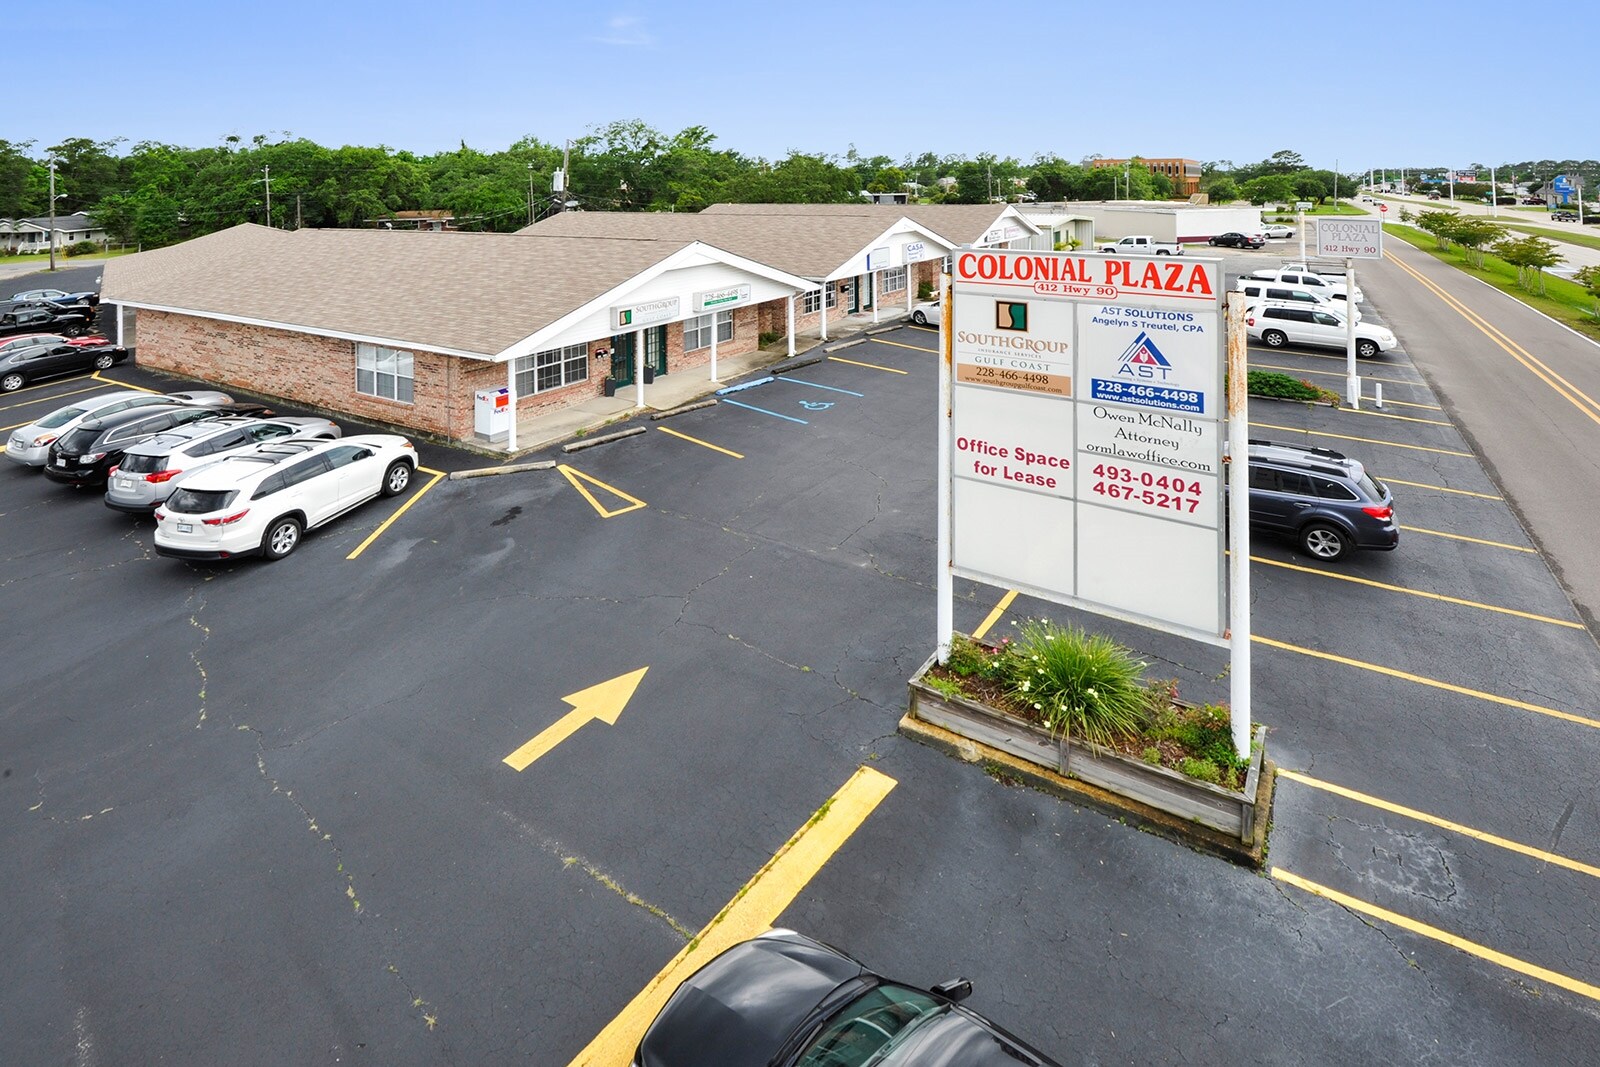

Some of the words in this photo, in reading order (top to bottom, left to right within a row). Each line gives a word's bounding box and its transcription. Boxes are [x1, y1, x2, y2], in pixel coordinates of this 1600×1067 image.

[1321, 223, 1378, 234] COLONIAL
[1331, 233, 1368, 242] PLAZA
[1323, 244, 1338, 252] 412
[1341, 245, 1360, 254] Hwy
[1363, 246, 1376, 254] 90
[958, 253, 1092, 283] COLONIAL
[1104, 260, 1213, 295] PLAZA
[1037, 283, 1058, 292] 412
[1063, 285, 1091, 296] Hwy
[1096, 286, 1115, 296] 90
[1101, 306, 1122, 315] AST
[1124, 308, 1194, 322] SOLUTIONS
[1092, 316, 1129, 327] Angelyn
[1140, 321, 1180, 332] Treutel,
[1182, 324, 1204, 333] CPA
[974, 355, 1005, 366] GULF
[1010, 360, 1051, 372] COAST
[1118, 363, 1172, 380] AST
[964, 375, 1063, 394] www.southgroupgulfcoast.com
[975, 366, 1049, 385] 228-466-4498
[1097, 381, 1198, 403] 228-466-4498
[1096, 392, 1200, 412] www.astsolutions.com
[1093, 406, 1135, 424] Owen
[1138, 412, 1203, 437] McNally
[1114, 427, 1180, 451] Attorney
[957, 437, 1009, 458] Office
[1014, 447, 1071, 469] Space
[1086, 443, 1211, 472] ormlawoffice.com
[973, 461, 998, 477] for
[1003, 467, 1057, 489] Lease
[1092, 464, 1202, 497] 493-0404
[1092, 481, 1200, 513] 467-5217
